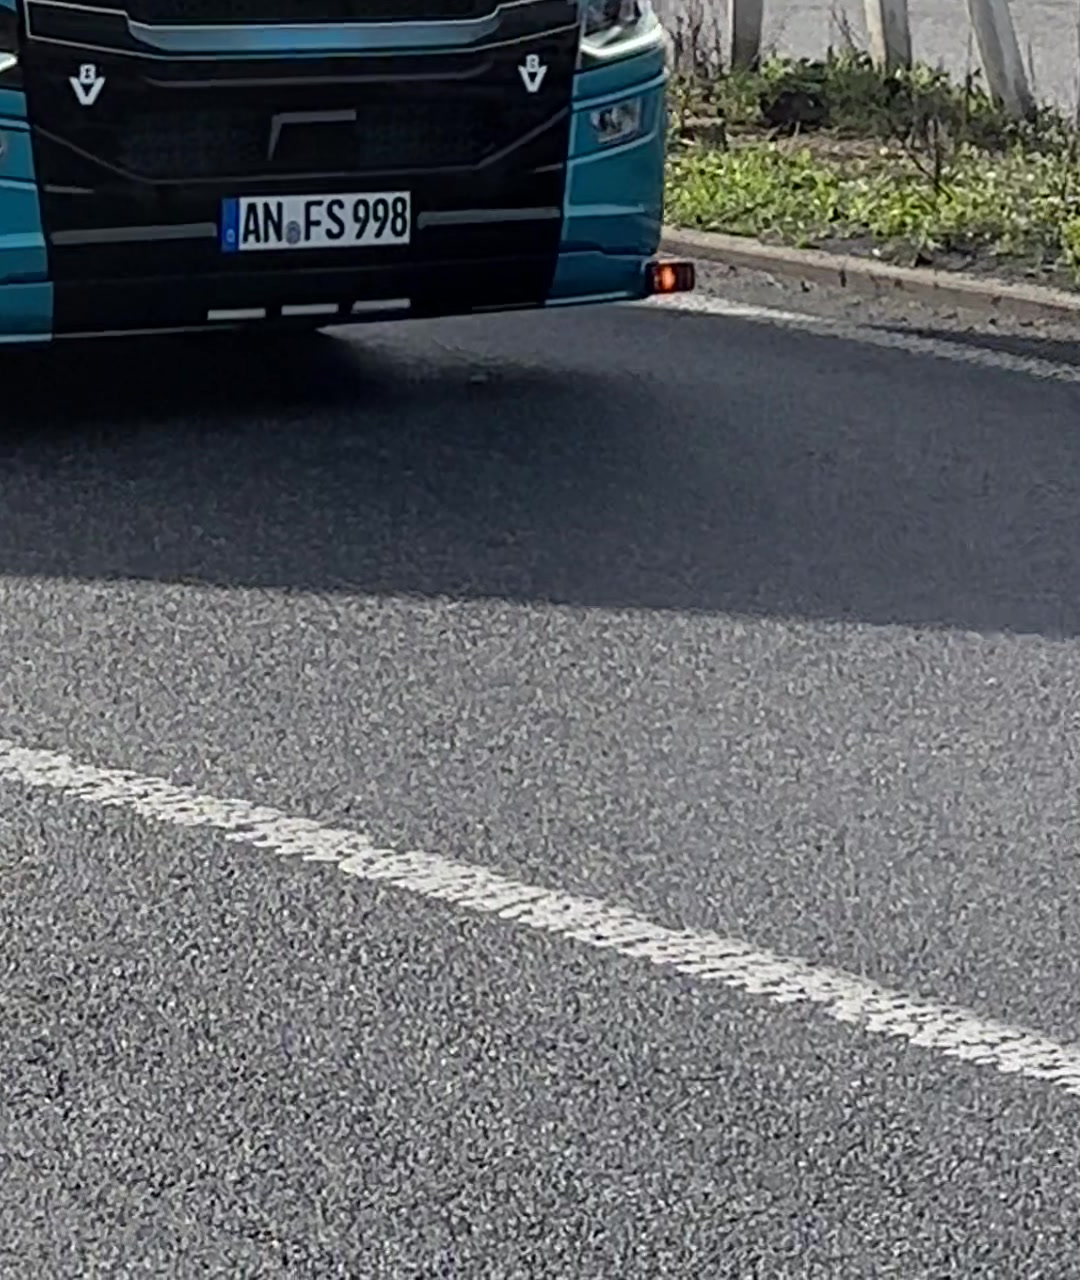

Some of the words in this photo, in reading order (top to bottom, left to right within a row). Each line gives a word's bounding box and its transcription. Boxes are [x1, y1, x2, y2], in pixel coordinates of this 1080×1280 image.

[242, 201, 284, 244] AN
[304, 198, 345, 242] FS
[353, 195, 408, 240] 998
